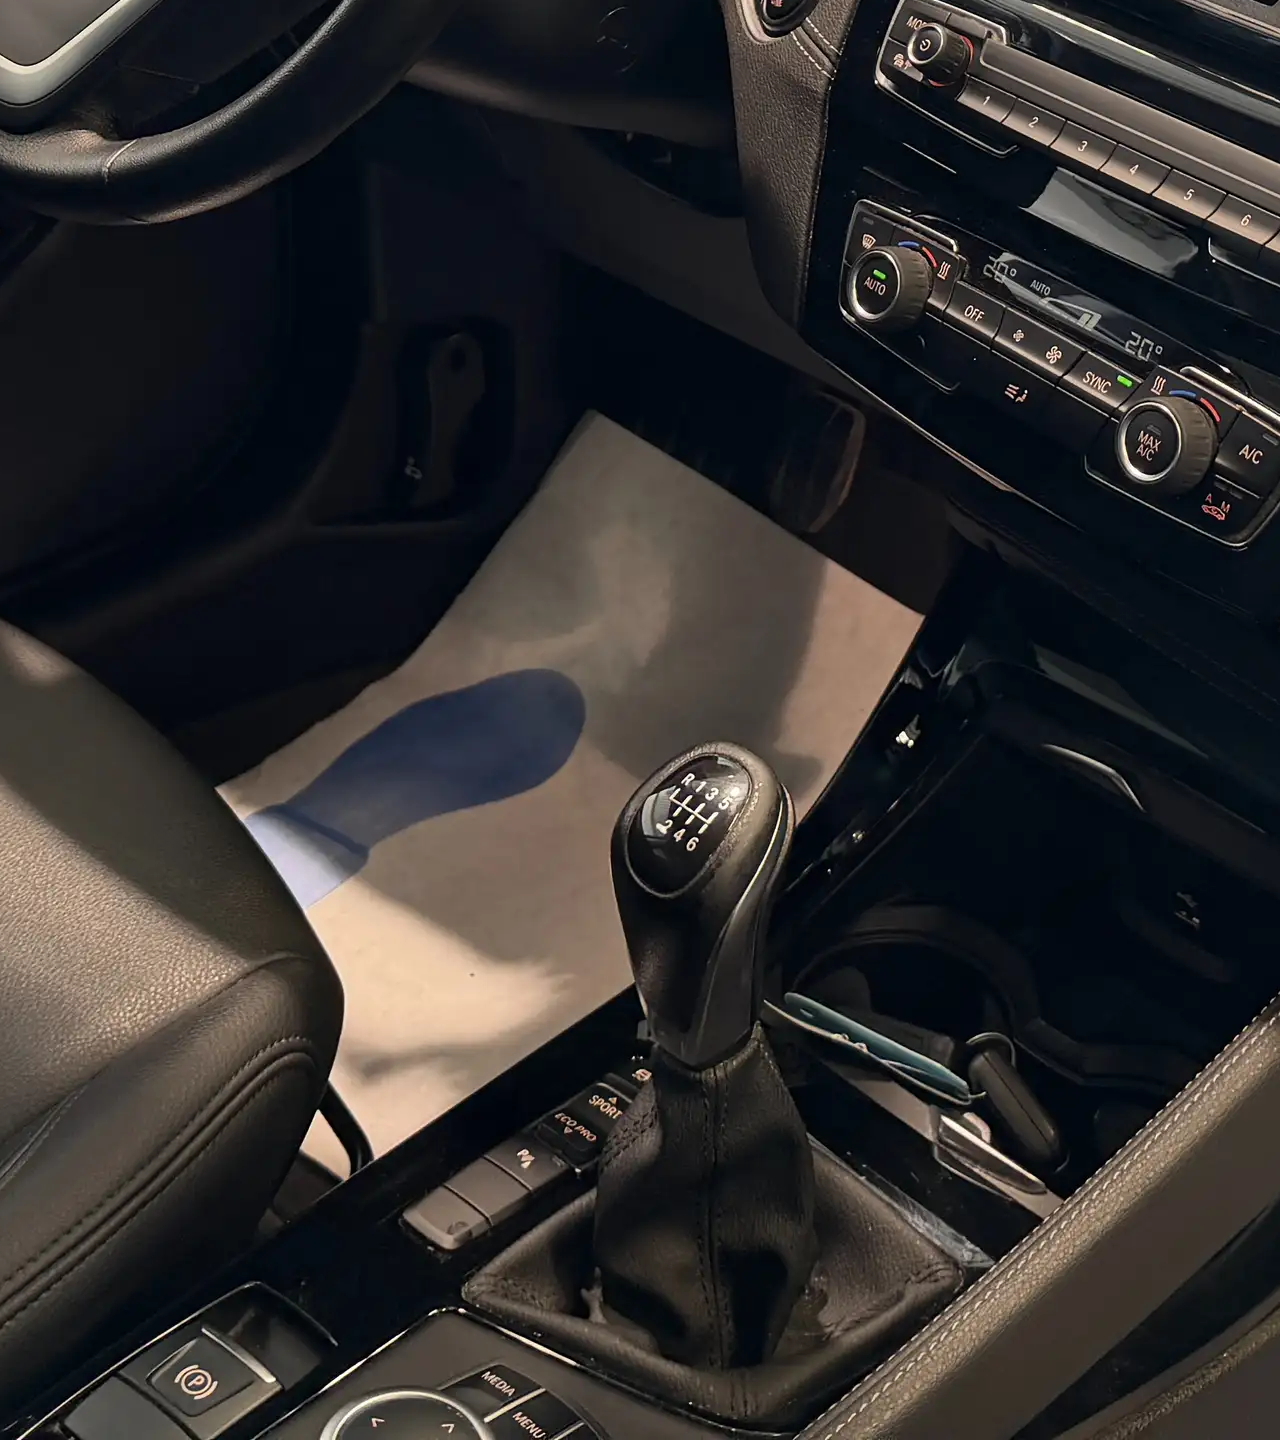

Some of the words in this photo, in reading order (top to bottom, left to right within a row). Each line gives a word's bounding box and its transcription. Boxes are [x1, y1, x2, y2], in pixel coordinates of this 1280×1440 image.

[983, 95, 991, 106] 1
[1028, 116, 1039, 128] 2
[1077, 140, 1088, 152] 3
[1129, 163, 1139, 176] 4
[1183, 188, 1195, 201] 5
[1240, 214, 1252, 227] 6
[863, 276, 887, 296] AUTO
[1030, 279, 1051, 297] AUTO
[963, 304, 985, 322] OFF
[1082, 371, 1112, 394] SYNC
[1138, 430, 1162, 452] MAX
[1136, 445, 1155, 462] A/C
[1238, 444, 1264, 465] A/C
[681, 773, 696, 787] R
[695, 782, 707, 793] 1
[705, 787, 719, 802] 3
[718, 796, 733, 811] 5
[656, 819, 674, 835] 2
[673, 828, 686, 843] 4
[686, 836, 700, 852] 6
[588, 1094, 623, 1120] SPORT
[554, 1112, 577, 1128] ECO
[574, 1125, 598, 1143] PRO
[480, 1370, 516, 1397] MEDIA
[512, 1411, 546, 1439] MENU
